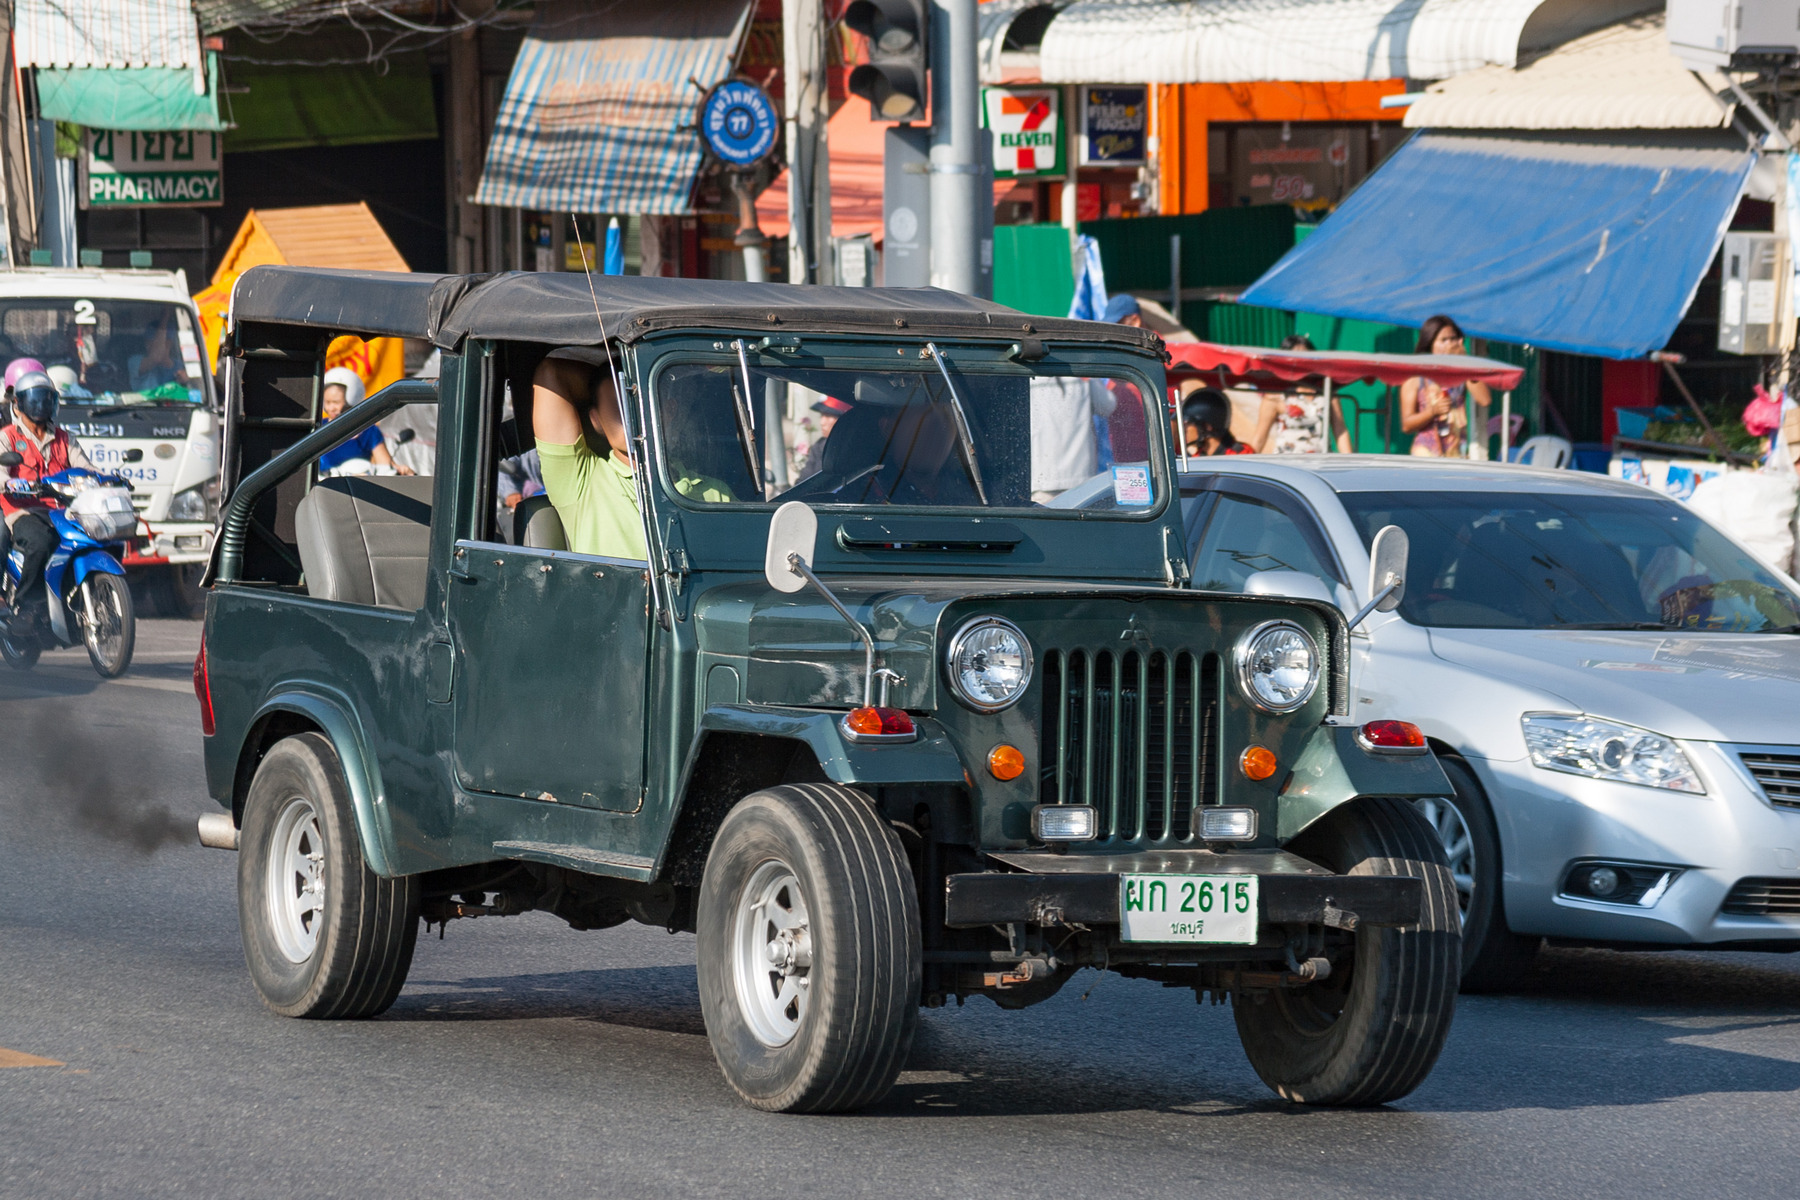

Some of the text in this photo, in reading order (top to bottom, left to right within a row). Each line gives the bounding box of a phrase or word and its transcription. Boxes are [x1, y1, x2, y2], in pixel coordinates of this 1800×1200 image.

[731, 115, 748, 132] 77
[1002, 96, 1050, 170] 7
[89, 177, 218, 200] PHARMACY
[73, 299, 97, 324] 2
[153, 426, 186, 437] NKR
[1129, 479, 1148, 488] 2556
[1180, 881, 1250, 914] 2615
[1170, 920, 1204, 939] ชลบุรี
